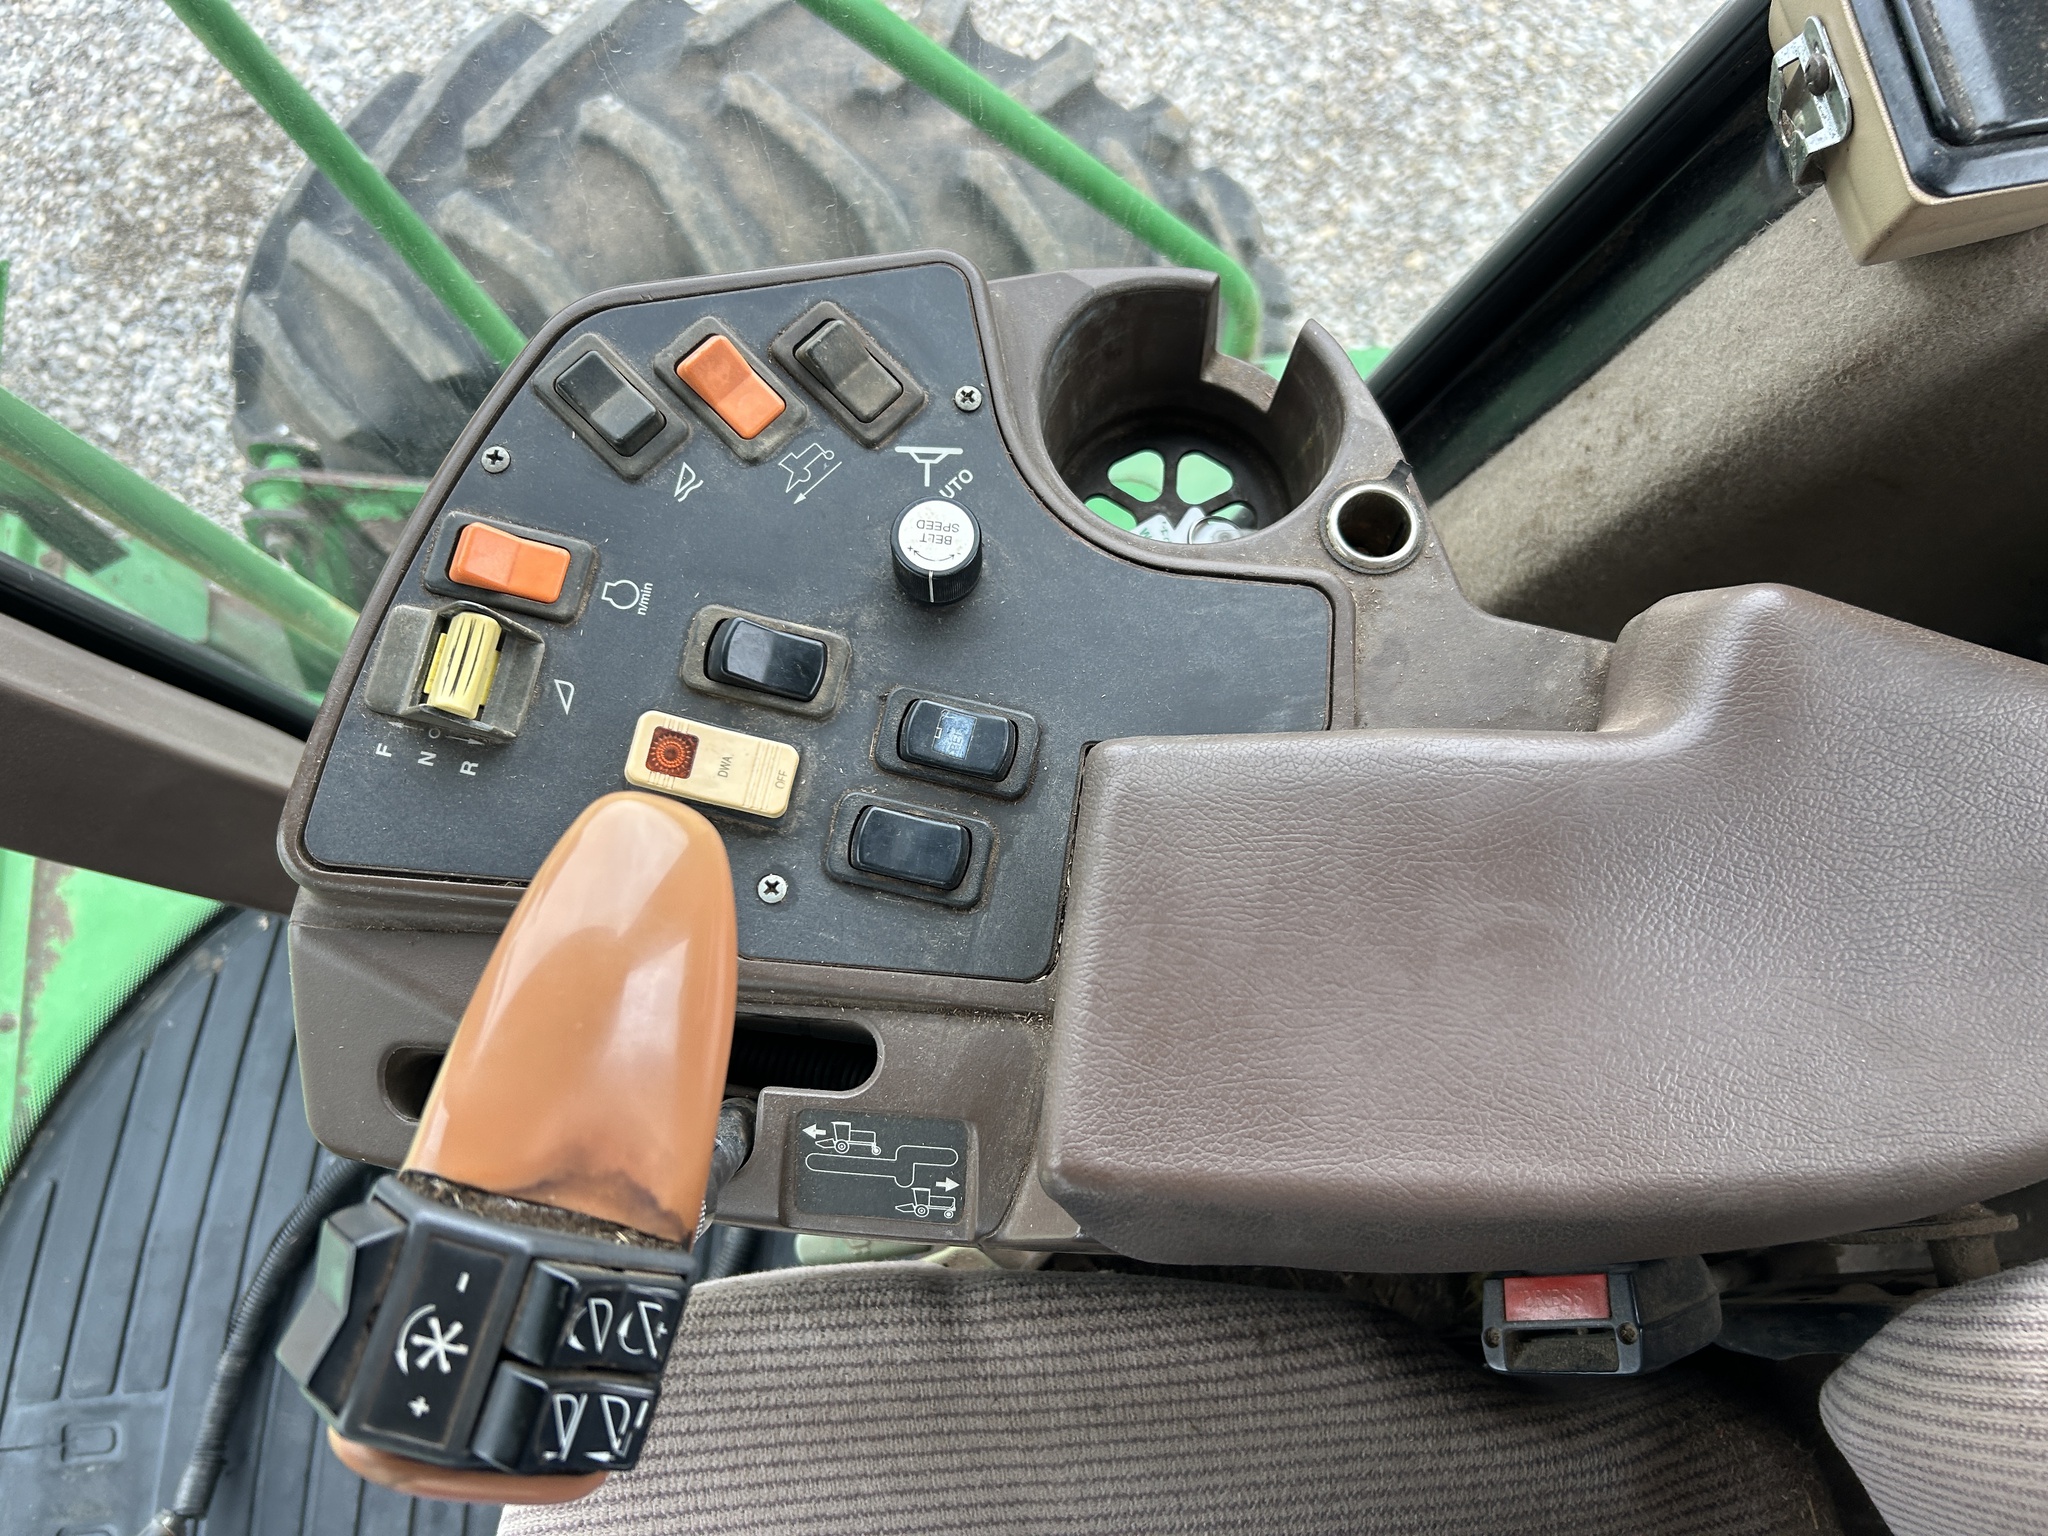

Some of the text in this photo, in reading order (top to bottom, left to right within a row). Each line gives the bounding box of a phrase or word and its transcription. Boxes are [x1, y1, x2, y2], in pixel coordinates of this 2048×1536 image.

[939, 469, 973, 499] UTO
[916, 519, 960, 533] SPEED
[919, 532, 953, 545] BELT
[637, 582, 653, 616] n/min
[375, 742, 392, 758] F
[417, 750, 437, 767] N
[459, 760, 479, 776] R
[717, 756, 733, 778] DWA
[774, 769, 788, 790] OFF
[1521, 1288, 1585, 1309] PRESS
